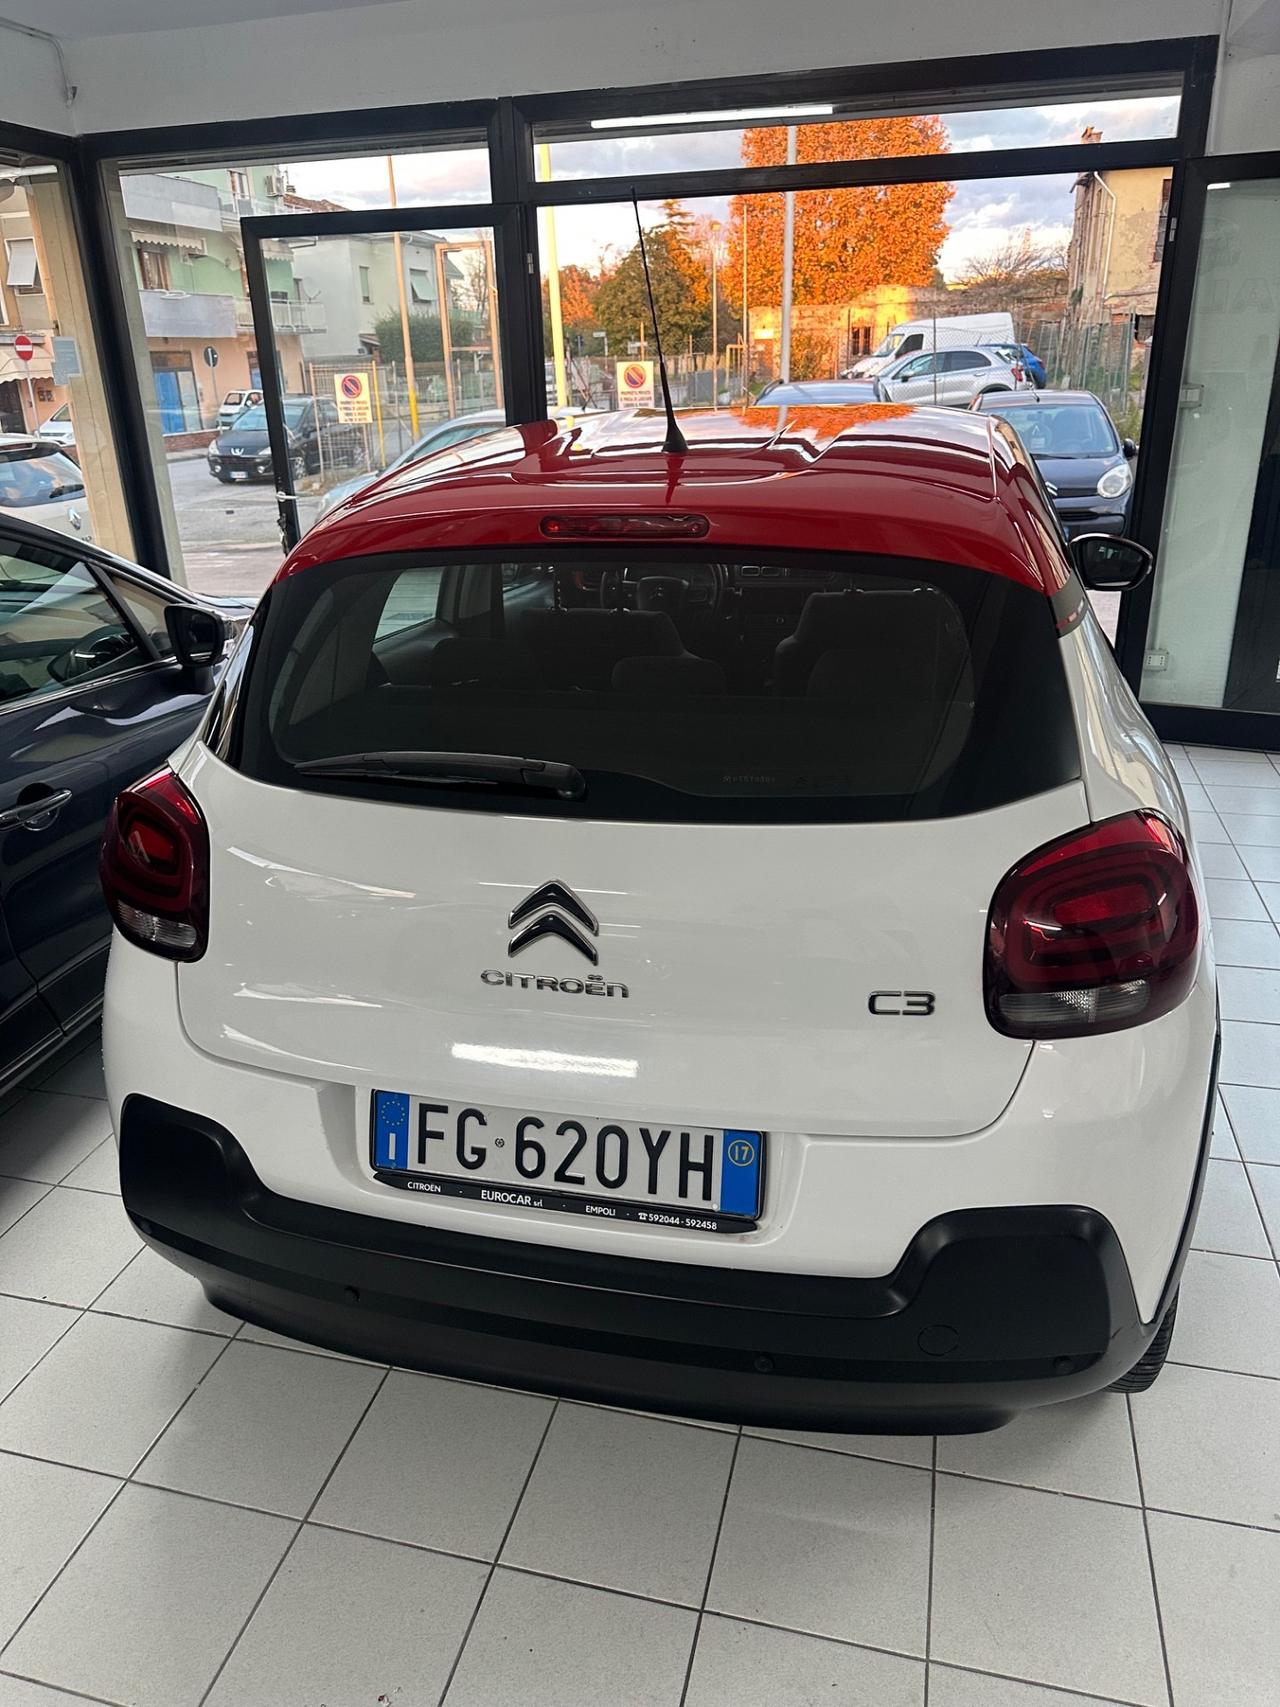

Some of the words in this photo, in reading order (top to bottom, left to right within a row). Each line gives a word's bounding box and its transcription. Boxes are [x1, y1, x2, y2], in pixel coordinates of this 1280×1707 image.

[868, 990, 936, 1016] C3
[417, 1101, 488, 1171] FG
[514, 1115, 715, 1202] 620YH
[407, 1181, 442, 1193] CITROEN
[480, 1188, 532, 1206] EUROCAR
[533, 1199, 543, 1208] srl
[585, 1205, 616, 1217] EMPOLI
